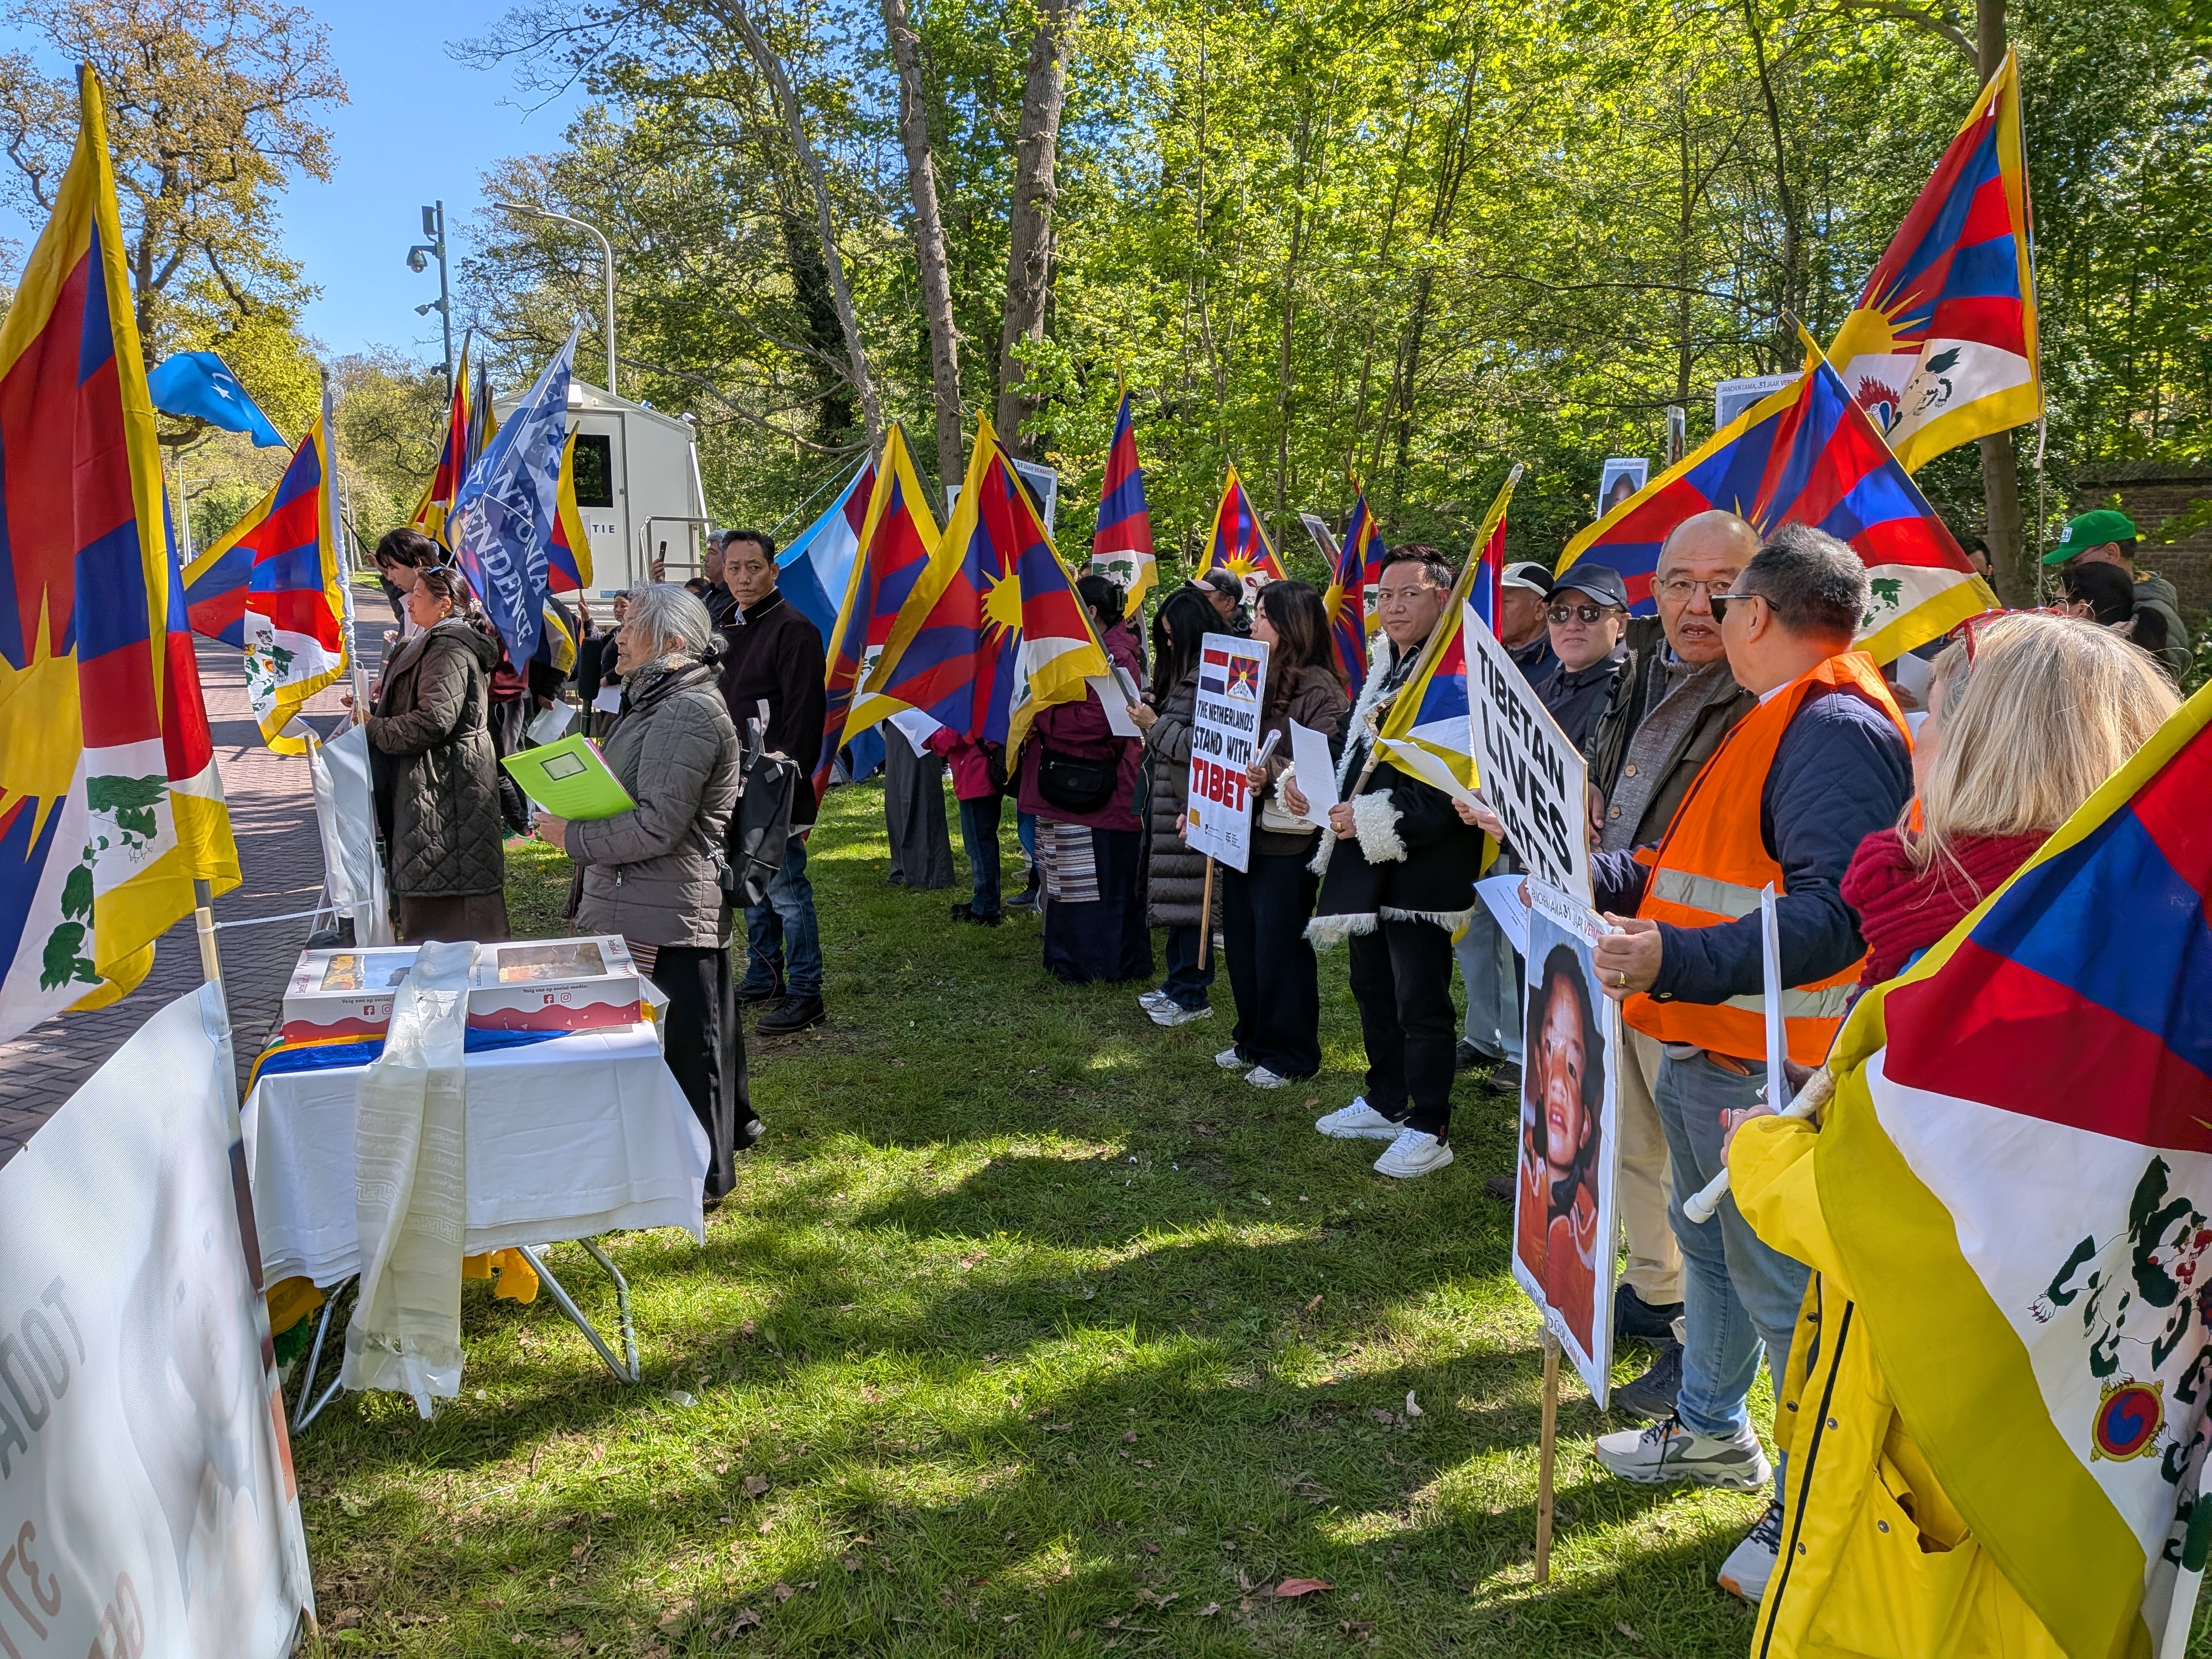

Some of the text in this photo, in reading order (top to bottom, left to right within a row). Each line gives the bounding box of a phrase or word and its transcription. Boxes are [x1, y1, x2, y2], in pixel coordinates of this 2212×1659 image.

[1034, 466, 1053, 476] VERMIST
[491, 469, 549, 596] NTONIA
[592, 524, 615, 534] TIE
[457, 498, 533, 648] PENDENCE
[1197, 700, 1255, 733] THE NETHERLANDS
[1477, 640, 1566, 803] TIBETAN
[1193, 725, 1252, 765] STAND WITH
[1192, 755, 1249, 812] TIBET
[1481, 698, 1573, 876] LIVES
[1488, 769, 1571, 895] MATTE
[1563, 904, 1572, 921] 31
[1566, 1337, 1581, 1370] CHINA
